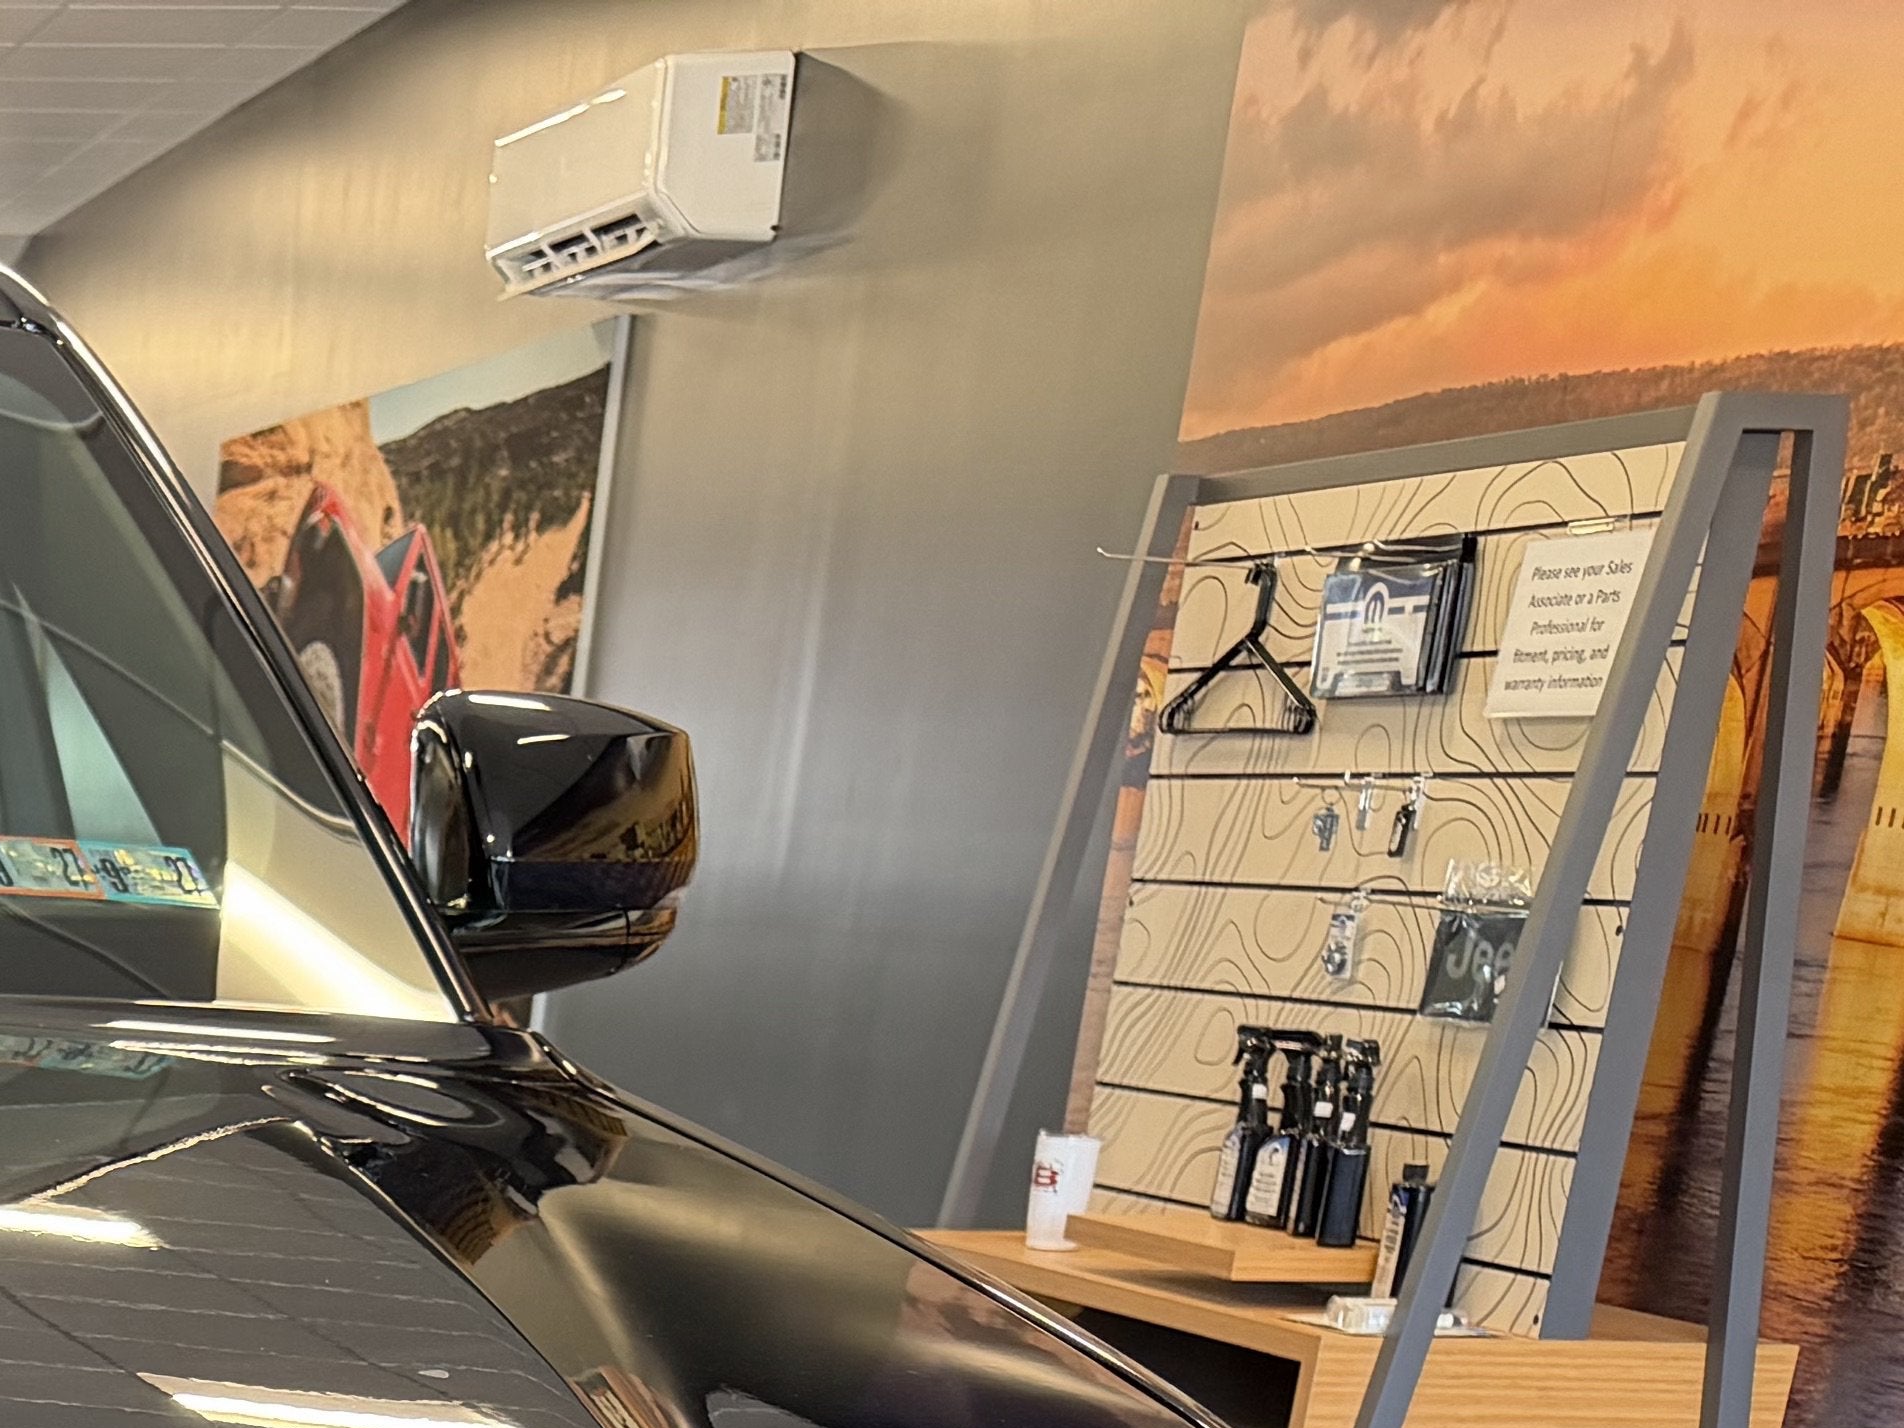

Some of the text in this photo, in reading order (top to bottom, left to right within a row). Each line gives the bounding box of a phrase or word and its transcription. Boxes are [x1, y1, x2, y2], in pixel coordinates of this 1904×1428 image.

[1531, 559, 1633, 581] Please see your Sales
[1528, 592, 1573, 608] Associate
[1574, 592, 1587, 603] or
[1595, 588, 1621, 604] Parts
[1529, 616, 1605, 635] Professional for
[1551, 645, 1587, 665] pricing,
[1589, 644, 1611, 661] and
[1504, 674, 1604, 692] warranty information
[1445, 927, 1517, 985] Jee
